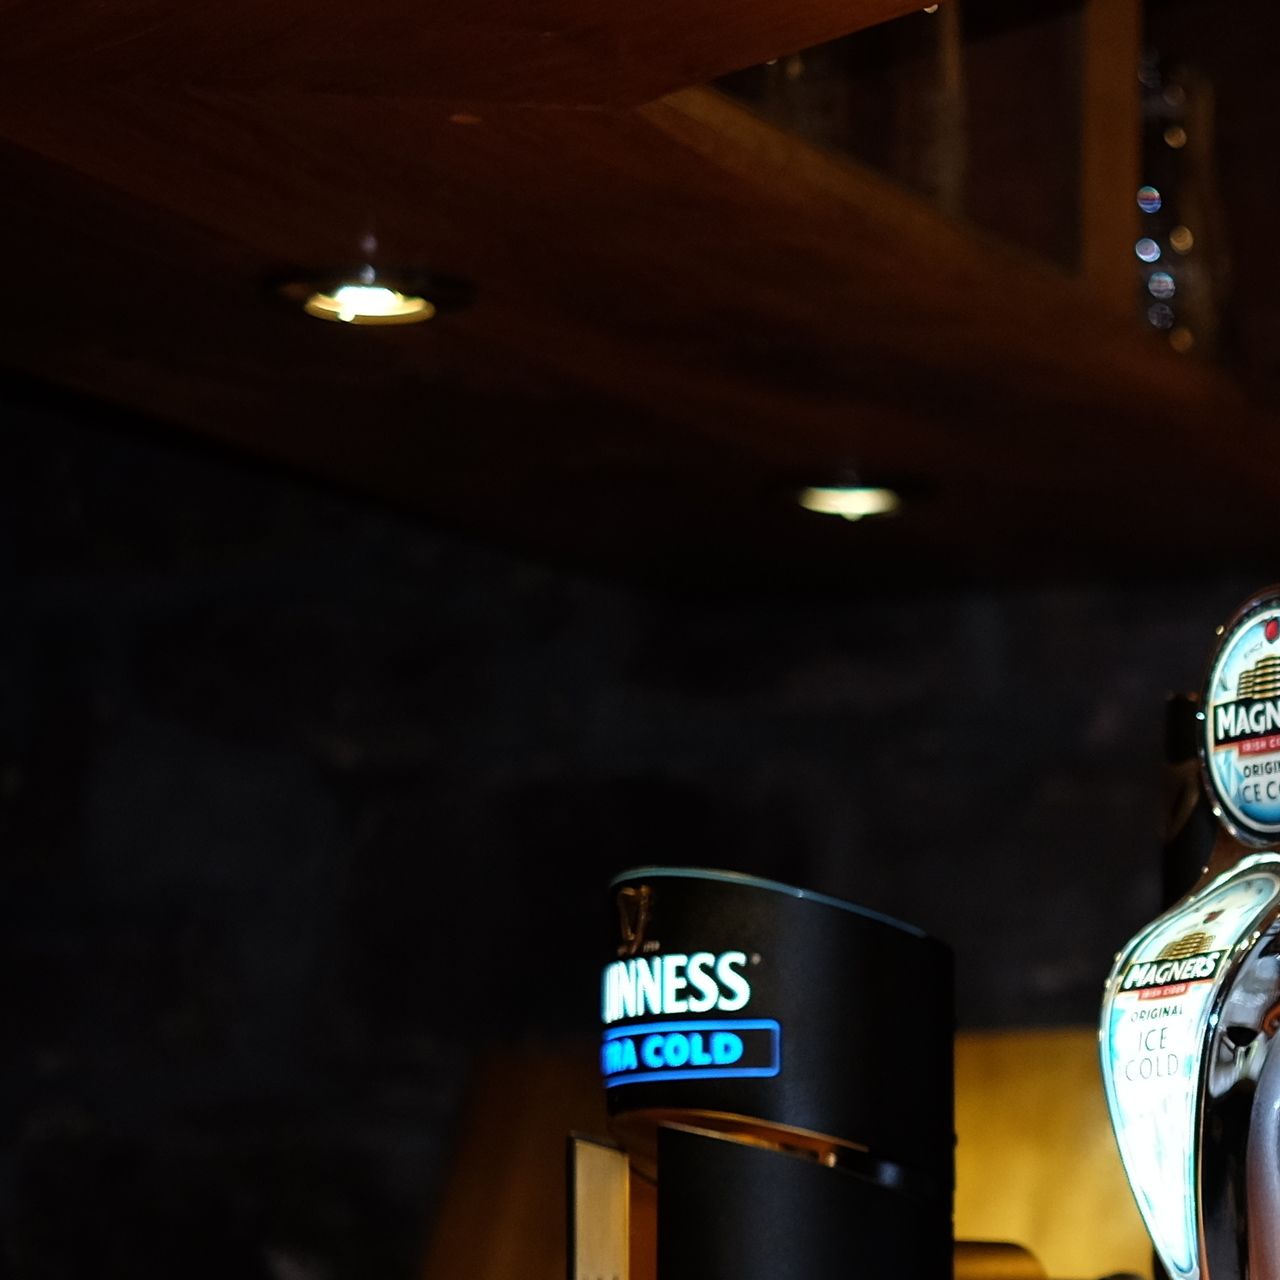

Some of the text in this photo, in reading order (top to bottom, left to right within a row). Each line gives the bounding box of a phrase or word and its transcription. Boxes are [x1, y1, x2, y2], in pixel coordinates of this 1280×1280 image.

[1123, 951, 1221, 989] MAGNERS
[641, 1031, 744, 1069] COLD
[1137, 1025, 1169, 1052] ICE
[1124, 1053, 1181, 1082] COLD
